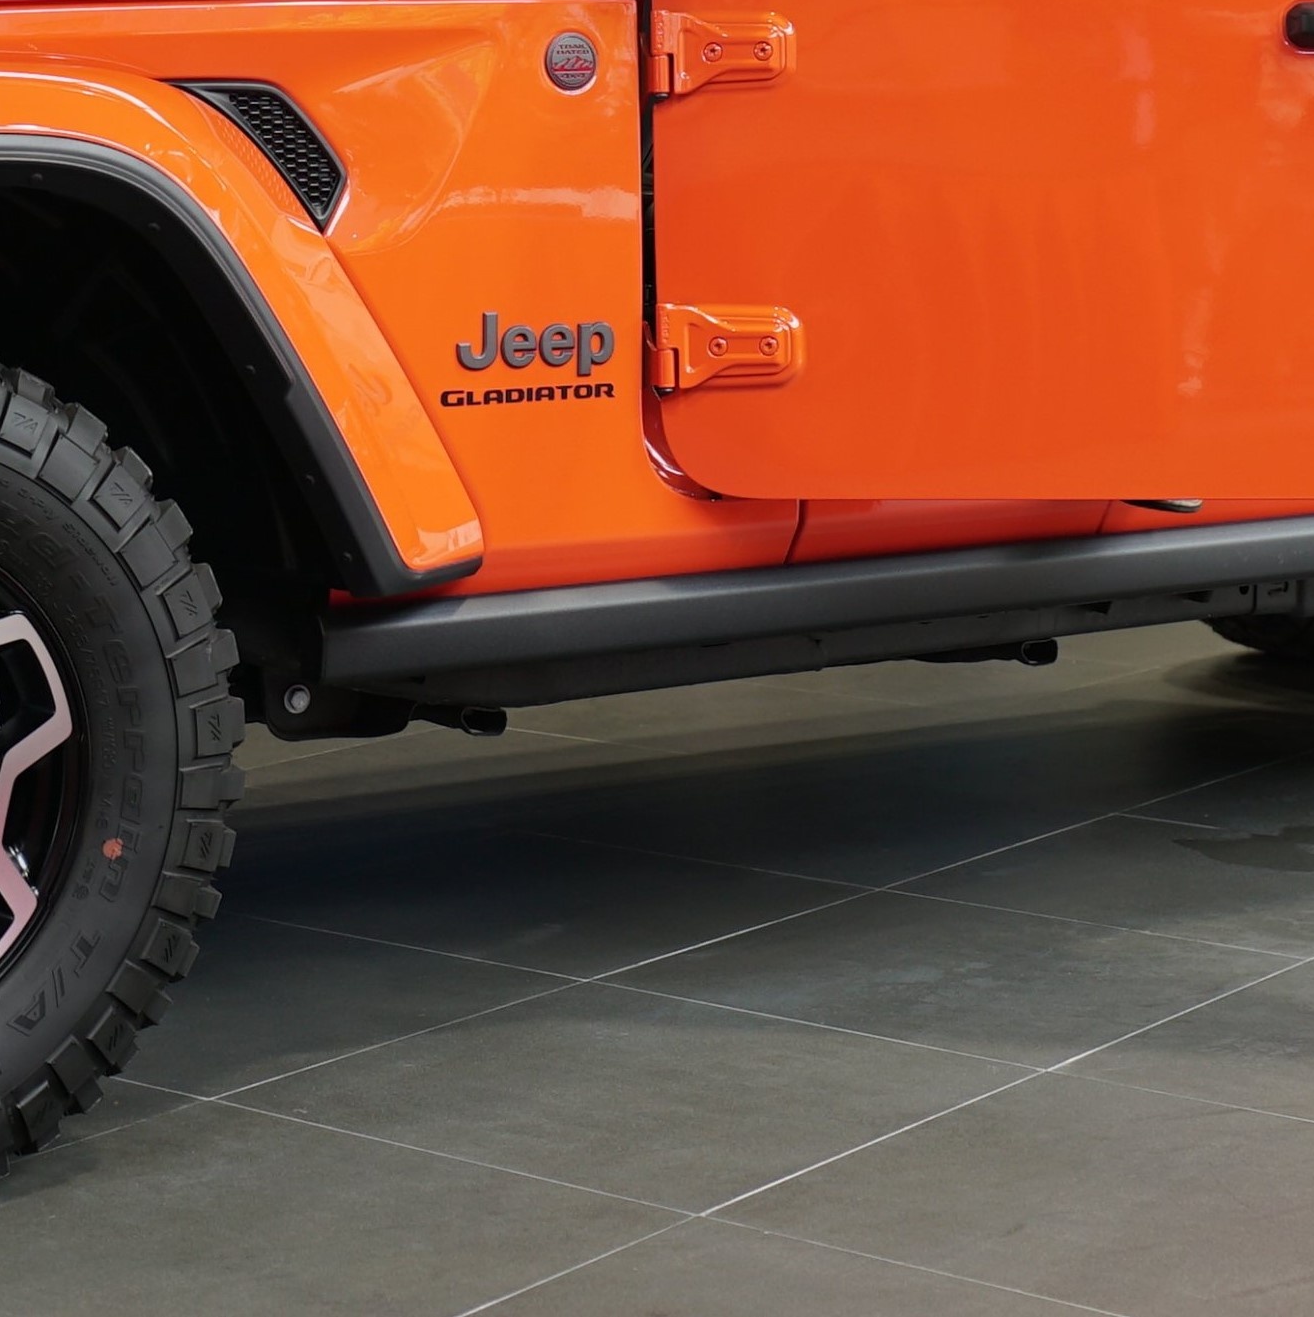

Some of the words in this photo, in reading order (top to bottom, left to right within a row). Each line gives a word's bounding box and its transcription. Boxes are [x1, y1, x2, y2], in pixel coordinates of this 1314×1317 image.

[456, 311, 615, 377] Jeep
[440, 383, 616, 407] GLADIATOR
[11, 412, 42, 436] T/A
[6, 927, 101, 1043] T/A
